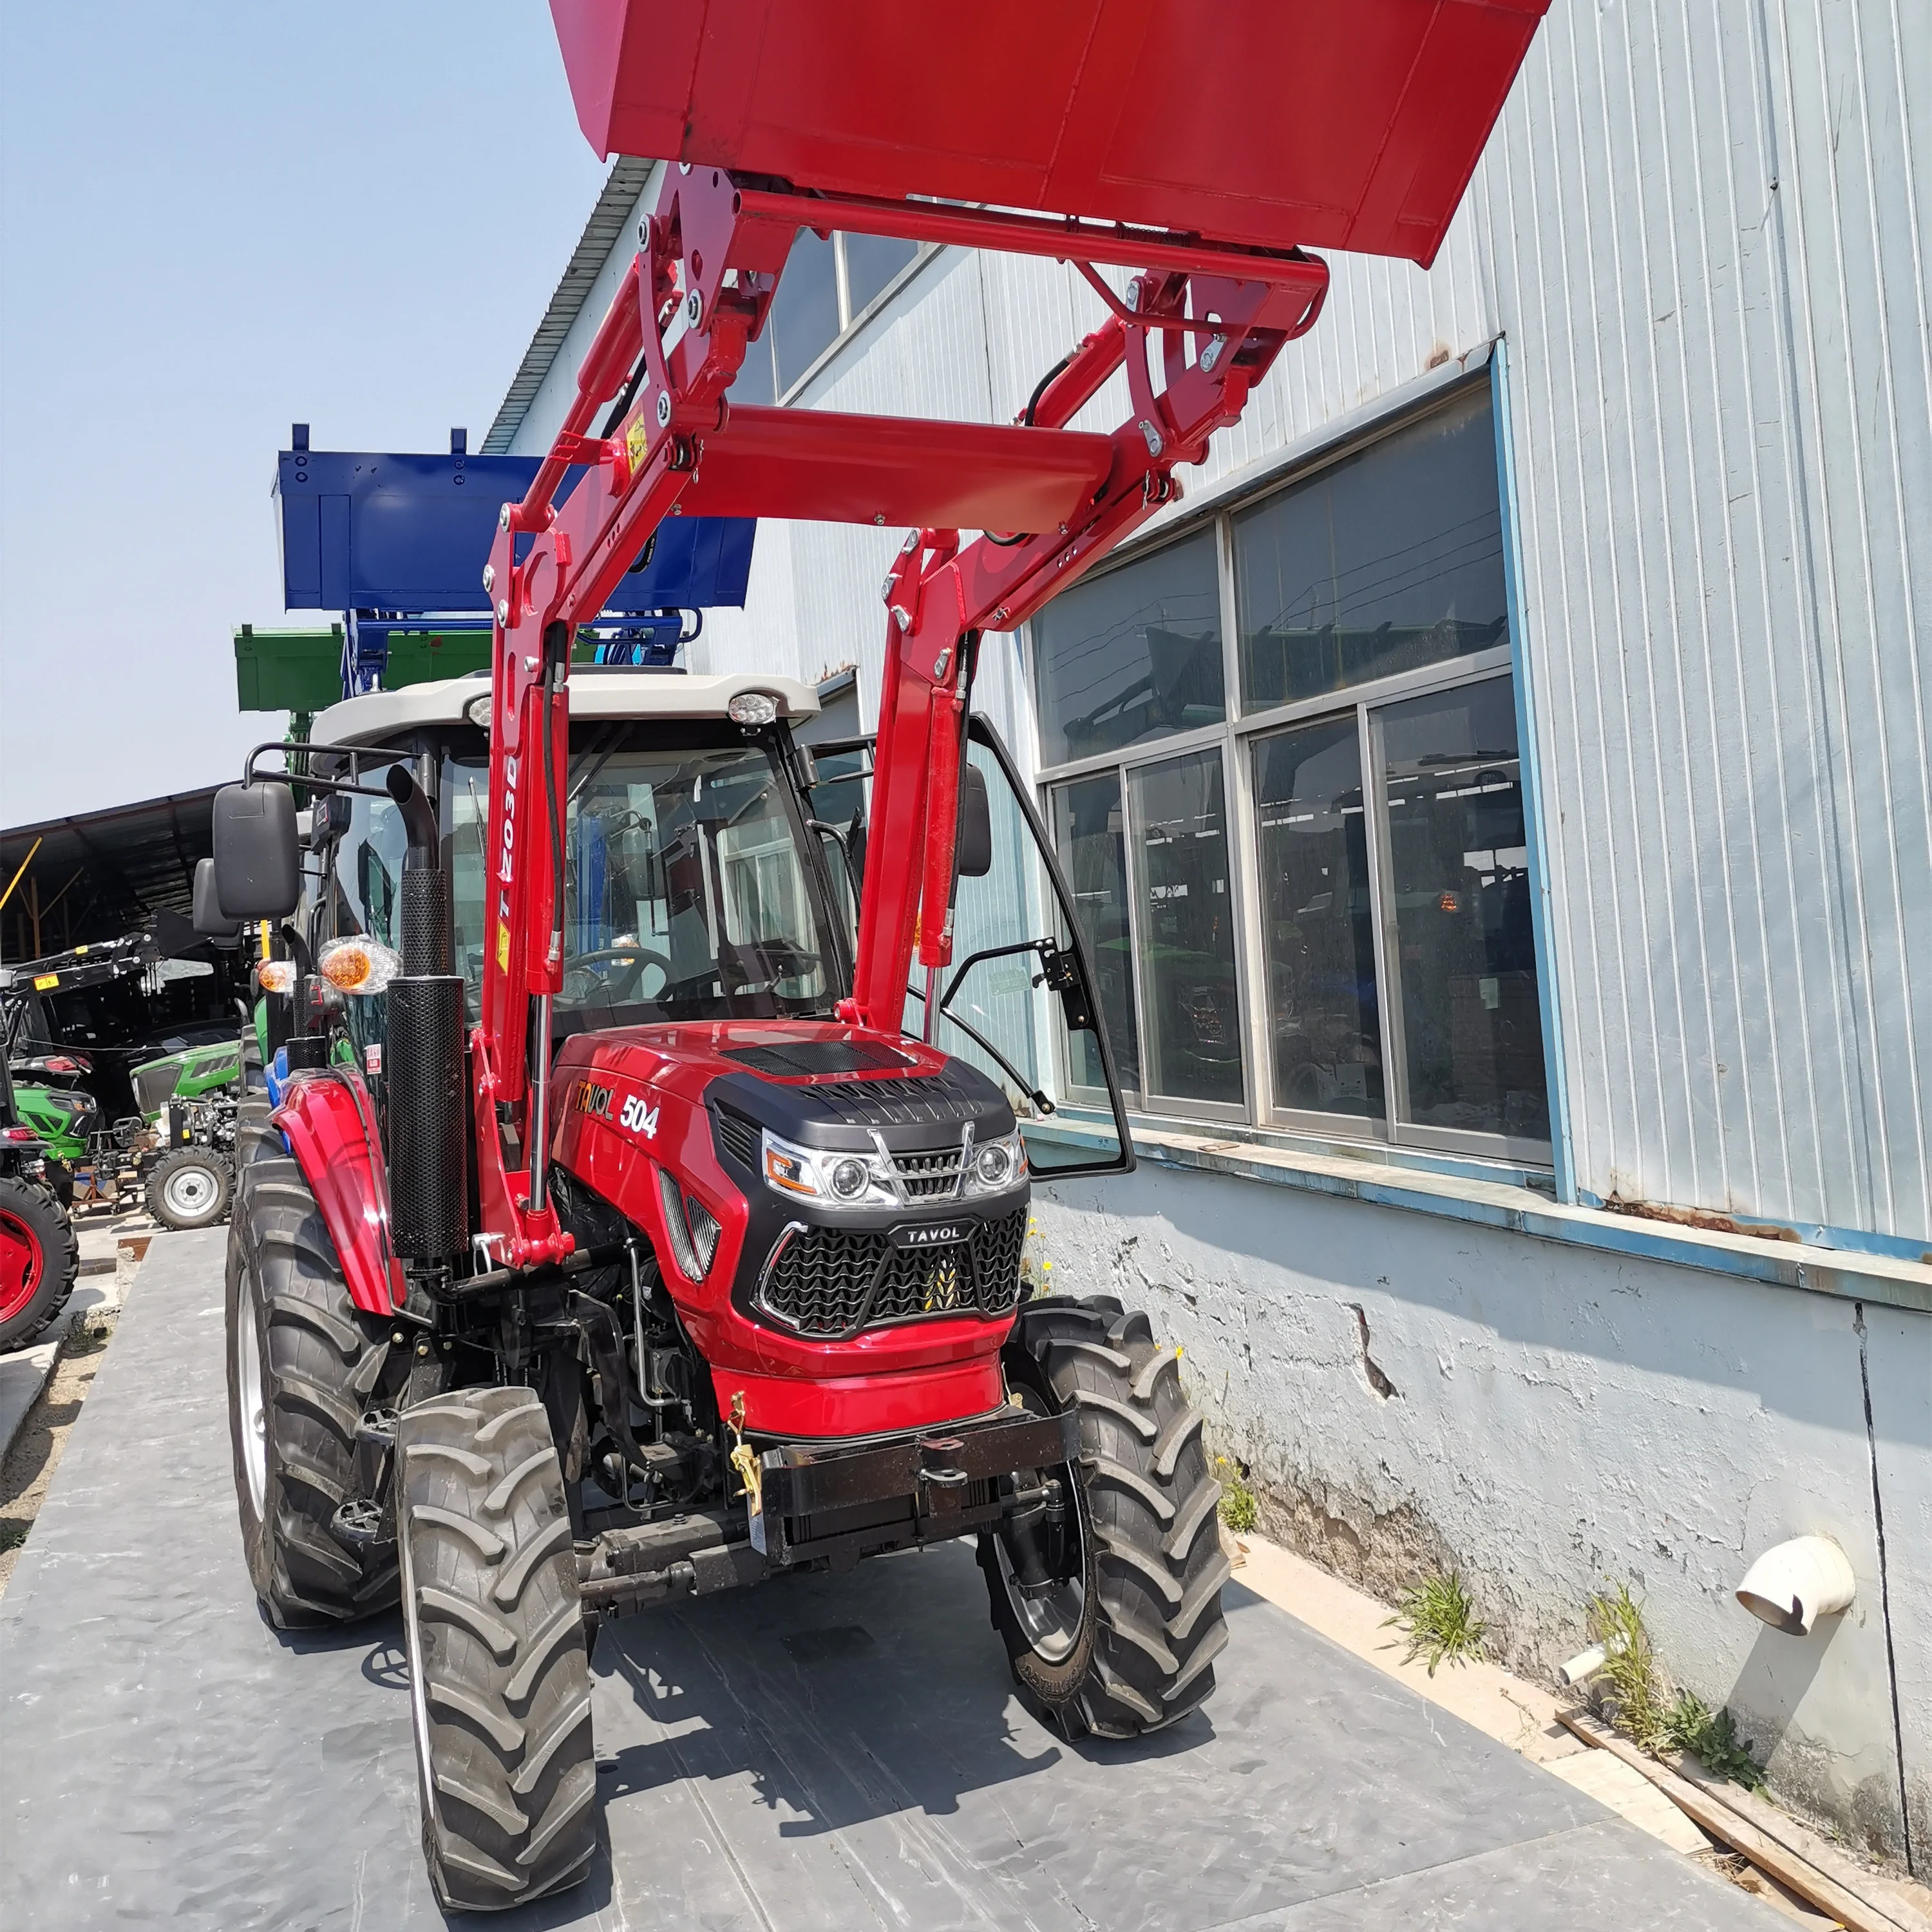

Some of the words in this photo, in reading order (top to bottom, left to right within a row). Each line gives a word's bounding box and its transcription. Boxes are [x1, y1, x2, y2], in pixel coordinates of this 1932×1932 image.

[575, 1080, 614, 1121] TAVOL
[620, 1095, 659, 1139] 504
[908, 1227, 960, 1242] TAVOL
